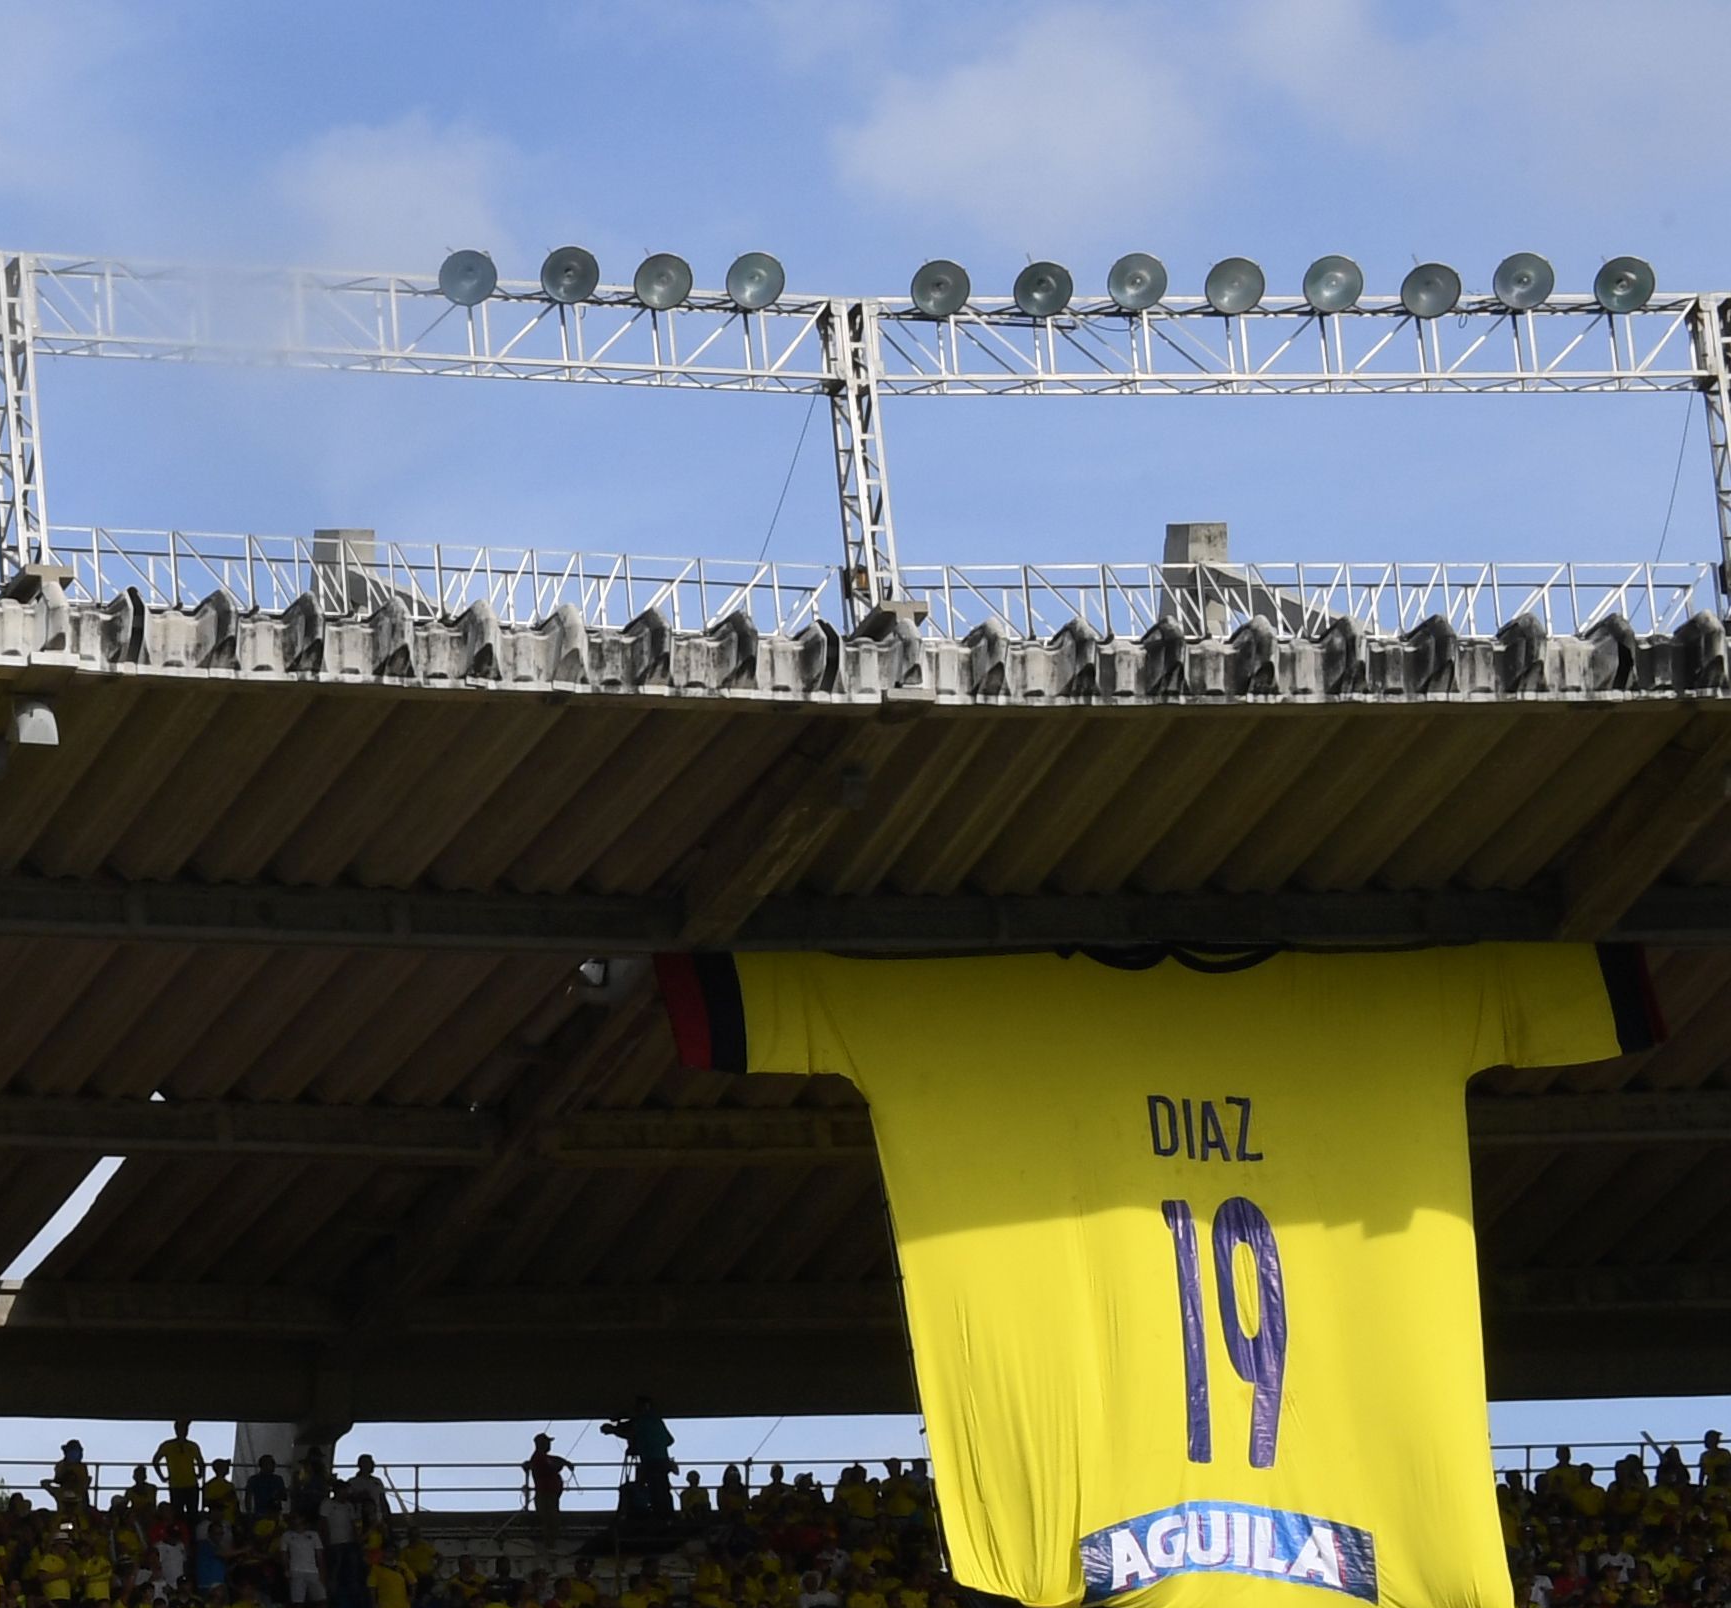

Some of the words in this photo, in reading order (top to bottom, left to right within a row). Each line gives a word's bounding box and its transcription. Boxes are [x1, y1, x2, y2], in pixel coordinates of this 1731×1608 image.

[1146, 1094, 1263, 1162] DIAZ
[1161, 1195, 1287, 1469] 19
[1110, 1511, 1345, 1590] AGUILA
